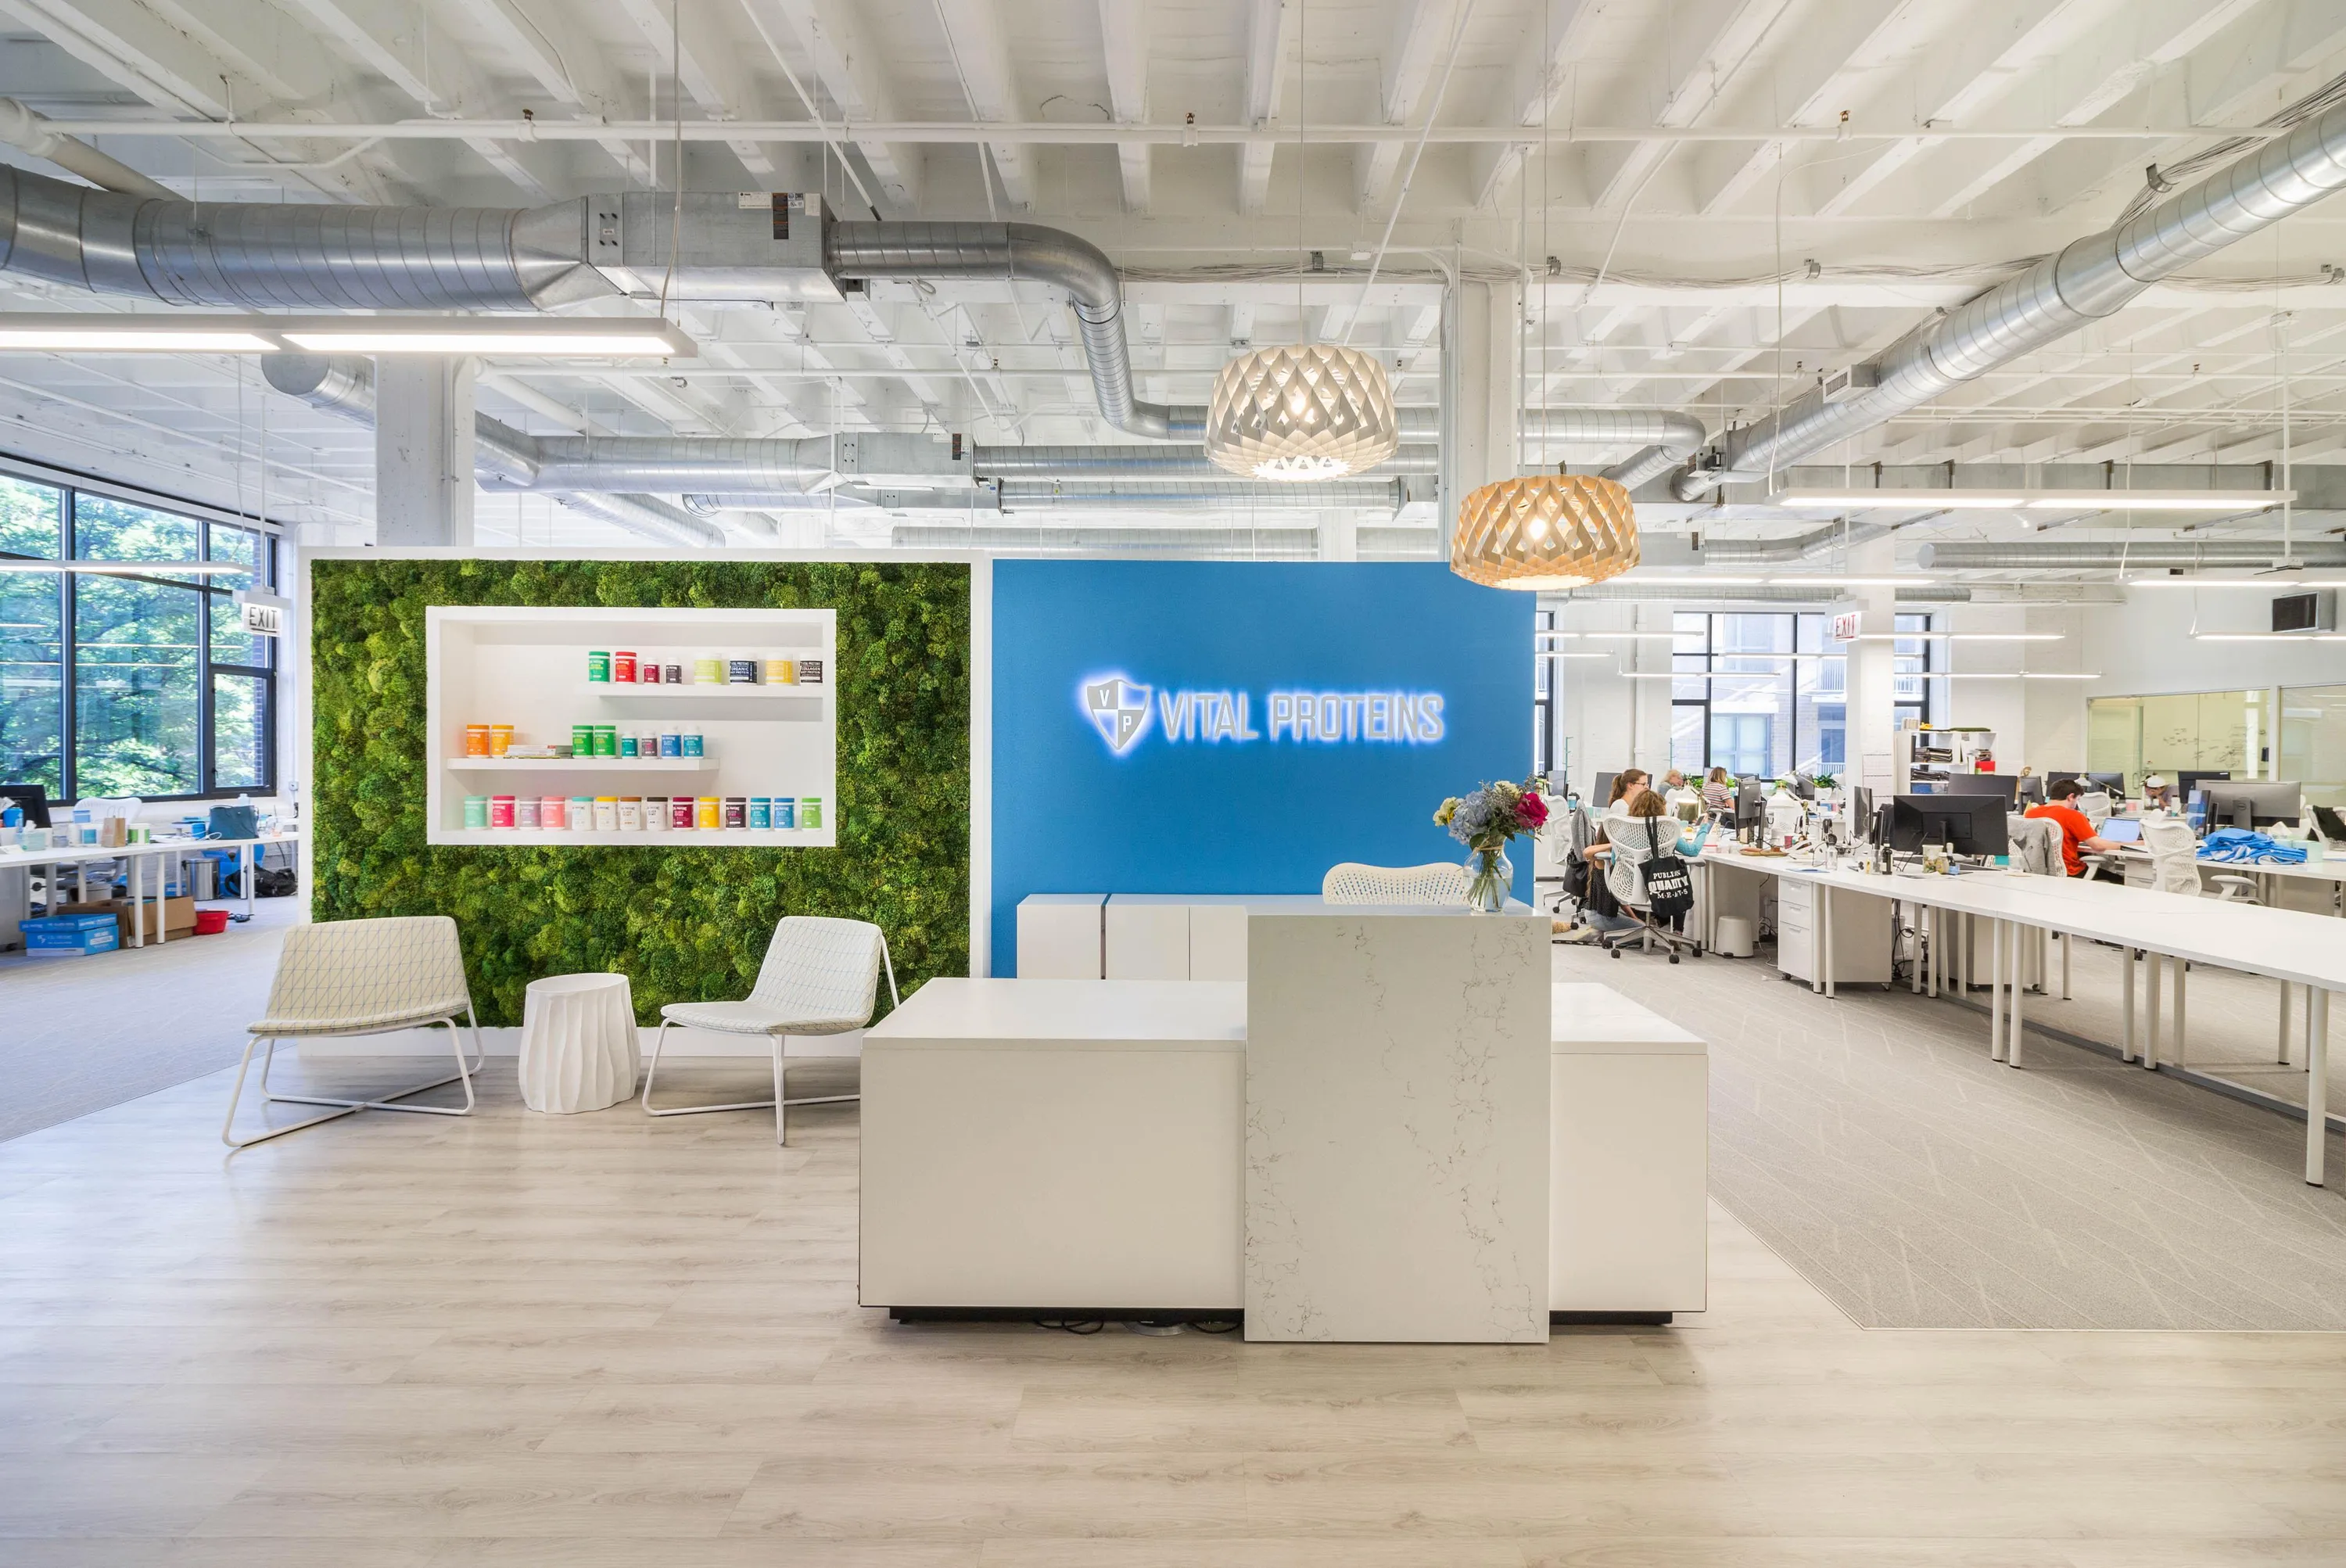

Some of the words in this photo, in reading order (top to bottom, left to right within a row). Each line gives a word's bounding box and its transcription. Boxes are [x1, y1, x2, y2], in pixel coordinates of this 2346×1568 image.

[249, 606, 278, 629] EXIT
[1835, 614, 1856, 637] EXIT
[1099, 689, 1110, 707] V
[1122, 716, 1132, 733] P
[1160, 694, 1259, 738] VITAL
[1272, 694, 1444, 739] PROTEINS
